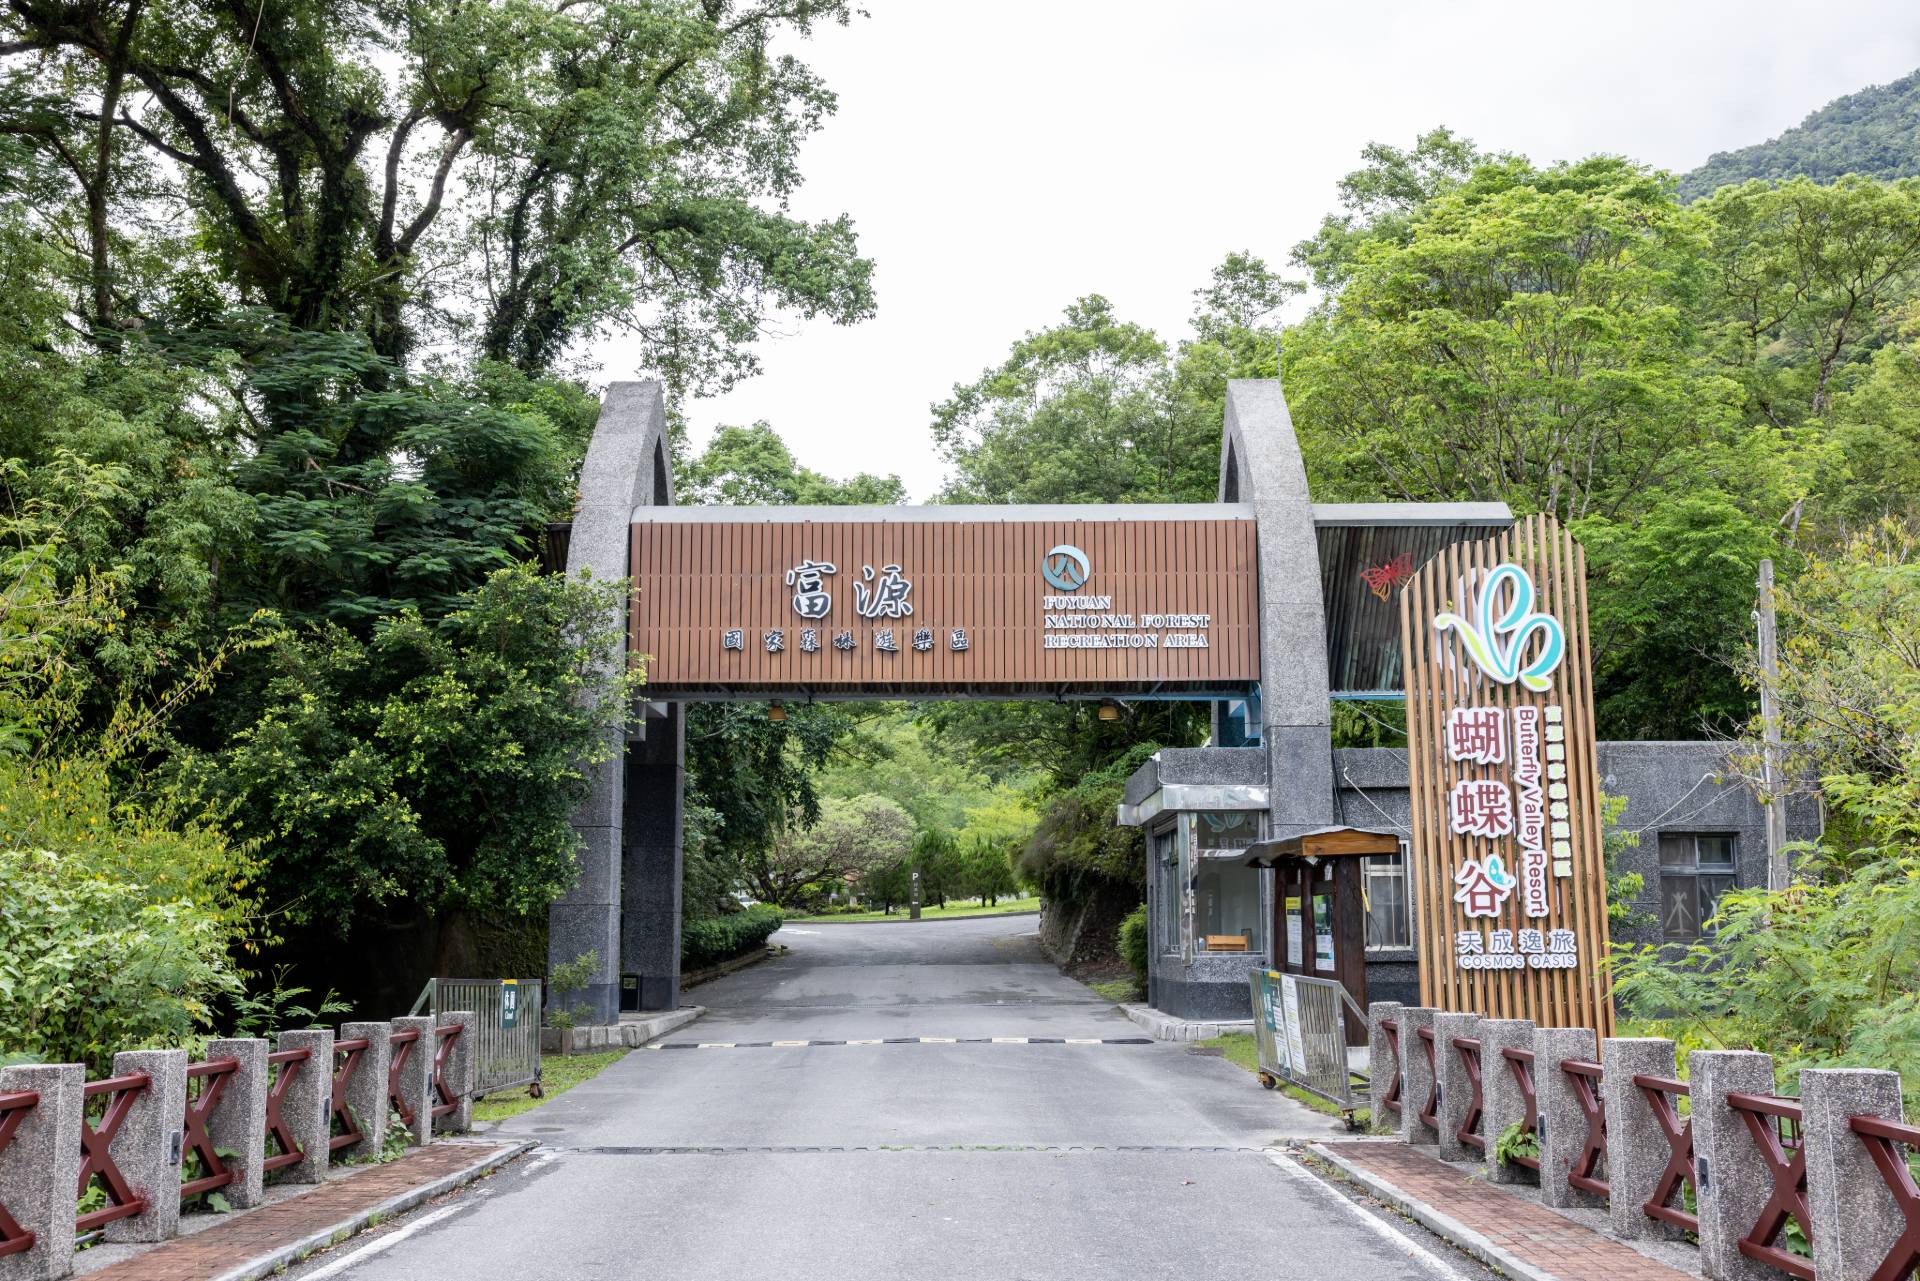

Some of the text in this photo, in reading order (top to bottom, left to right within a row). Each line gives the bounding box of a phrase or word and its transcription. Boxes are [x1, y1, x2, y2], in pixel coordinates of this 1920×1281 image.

[787, 561, 913, 618] 富源
[1044, 596, 1111, 609] FUYUAN
[1045, 615, 1210, 628] NATIONAL FOREST
[724, 628, 969, 651] 國家森林遊樂區
[1045, 634, 1209, 648] RECREATION AREA
[1452, 711, 1509, 913] 蝴蝶谷
[1520, 709, 1545, 914] Butterfly Valley Resort
[912, 872, 918, 880] P
[1461, 931, 1576, 952] 天成逸旅
[1462, 955, 1576, 967] COSMOS OASIS
